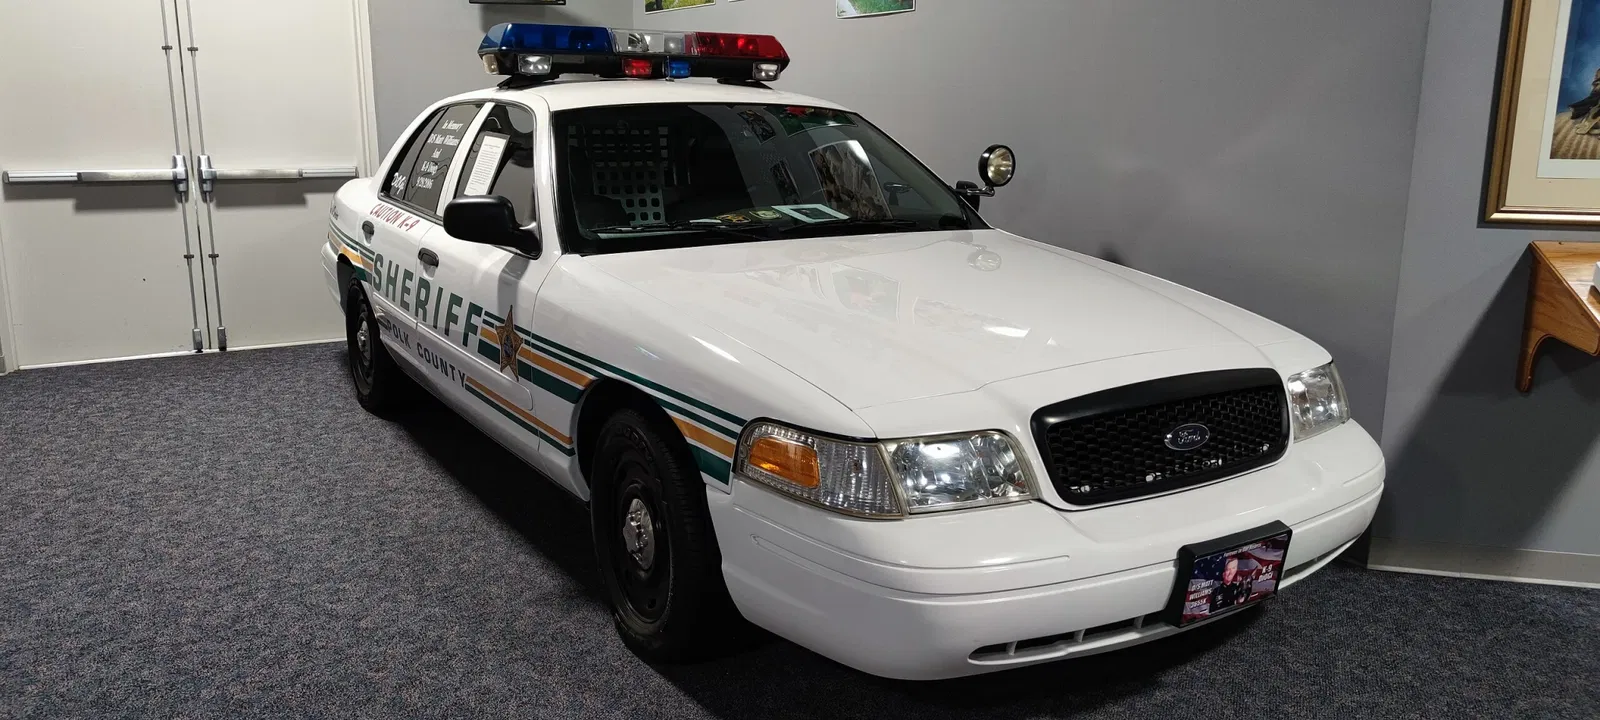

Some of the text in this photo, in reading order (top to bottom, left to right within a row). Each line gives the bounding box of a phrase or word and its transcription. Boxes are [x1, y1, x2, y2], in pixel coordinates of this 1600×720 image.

[446, 120, 463, 132] Memory
[443, 135, 460, 146] Williams
[369, 202, 421, 232] CAUTION K-9
[373, 253, 484, 348] SHERIFF
[386, 319, 466, 388] POLK COUNTY
[1177, 429, 1201, 445] Ford
[1262, 564, 1273, 573] K-9
[1200, 579, 1214, 589] MATT
[1189, 587, 1213, 601] WILLIAMS
